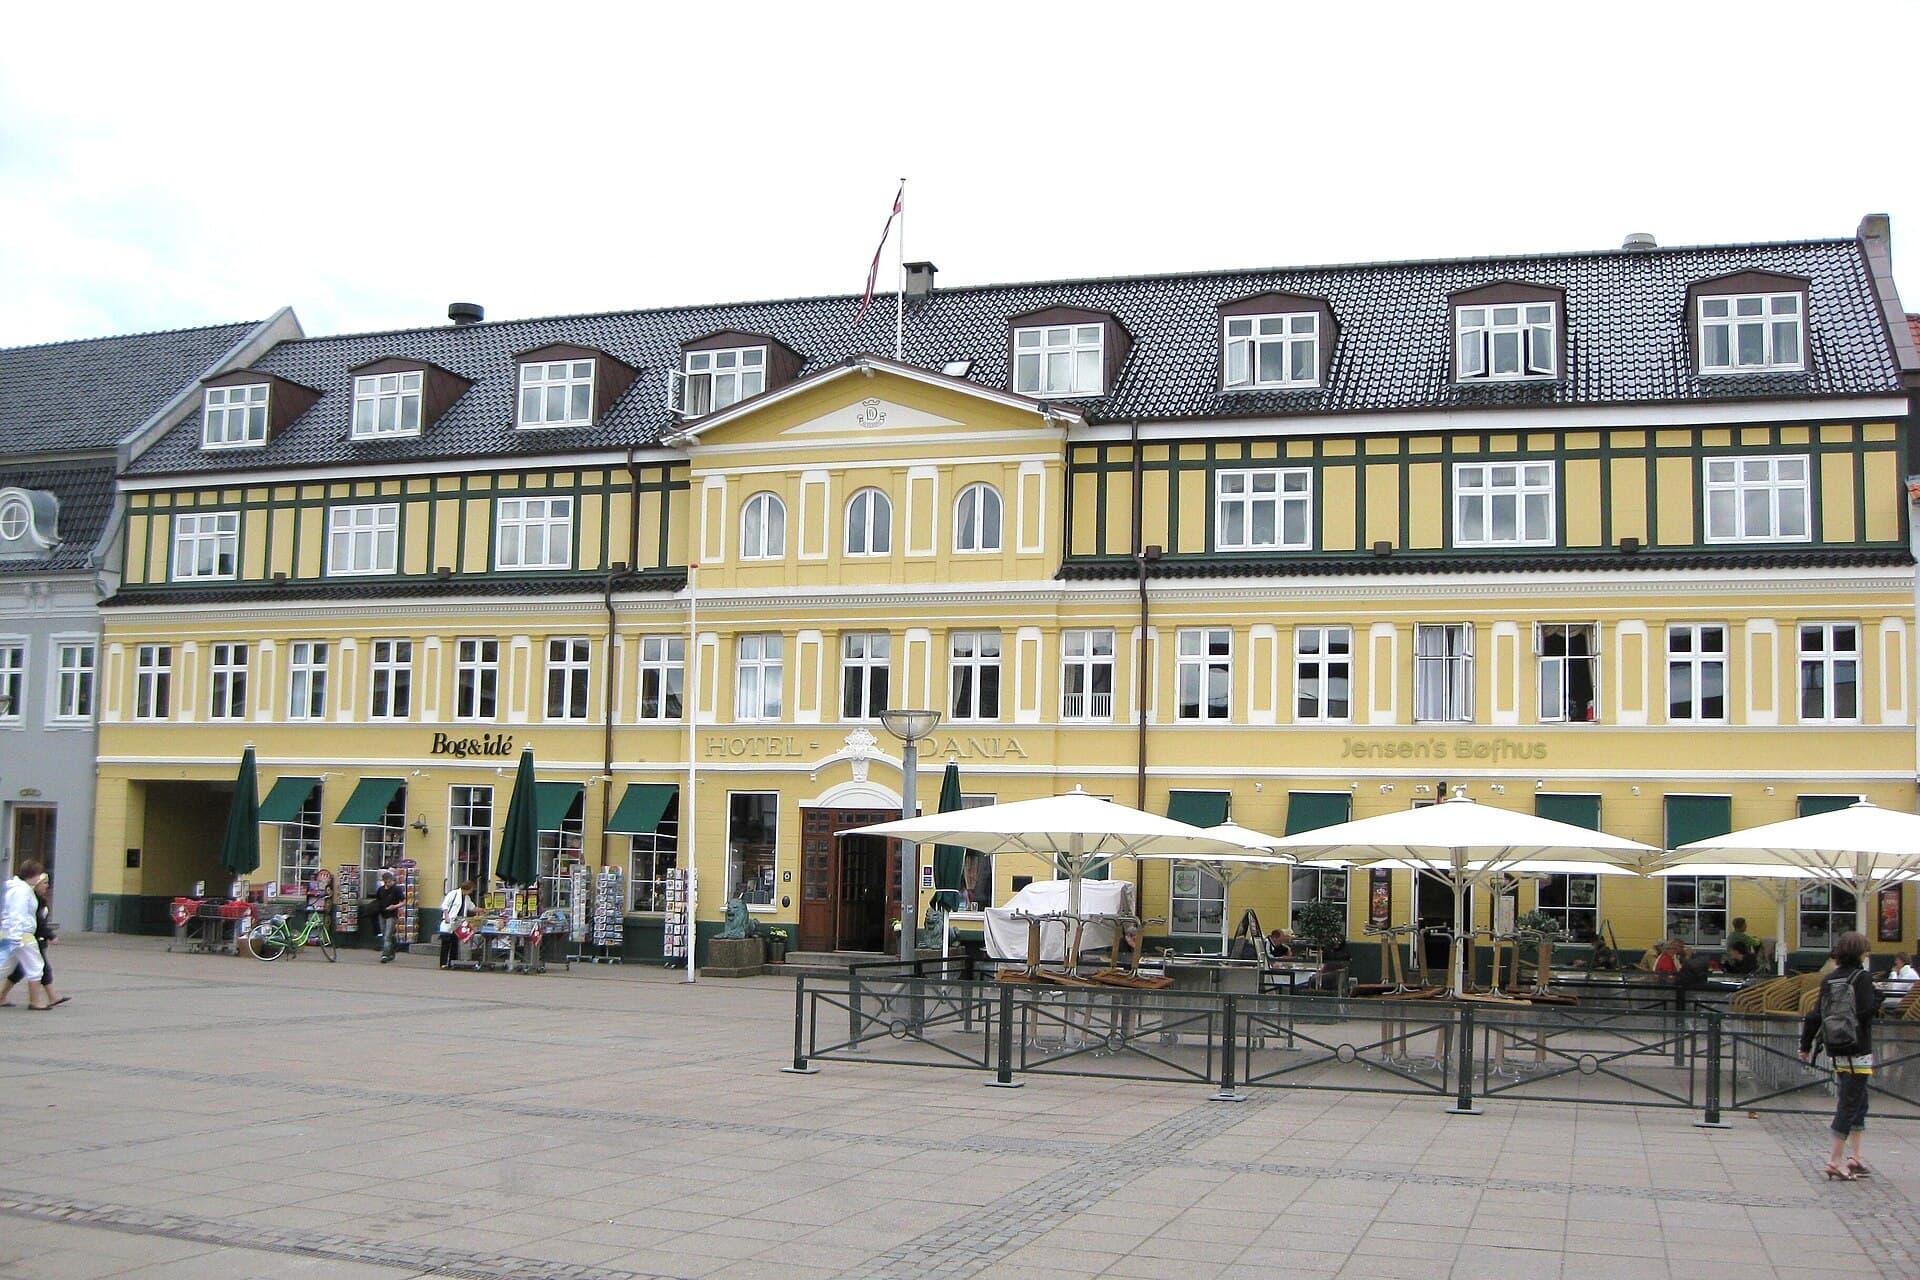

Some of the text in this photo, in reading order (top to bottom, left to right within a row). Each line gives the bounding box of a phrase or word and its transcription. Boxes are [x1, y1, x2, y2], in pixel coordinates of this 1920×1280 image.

[430, 732, 514, 759] Bog&idé
[704, 736, 803, 757] HOTEL
[918, 736, 1028, 759] DANIA
[1341, 736, 1548, 763] Jensen's Bøfhus
